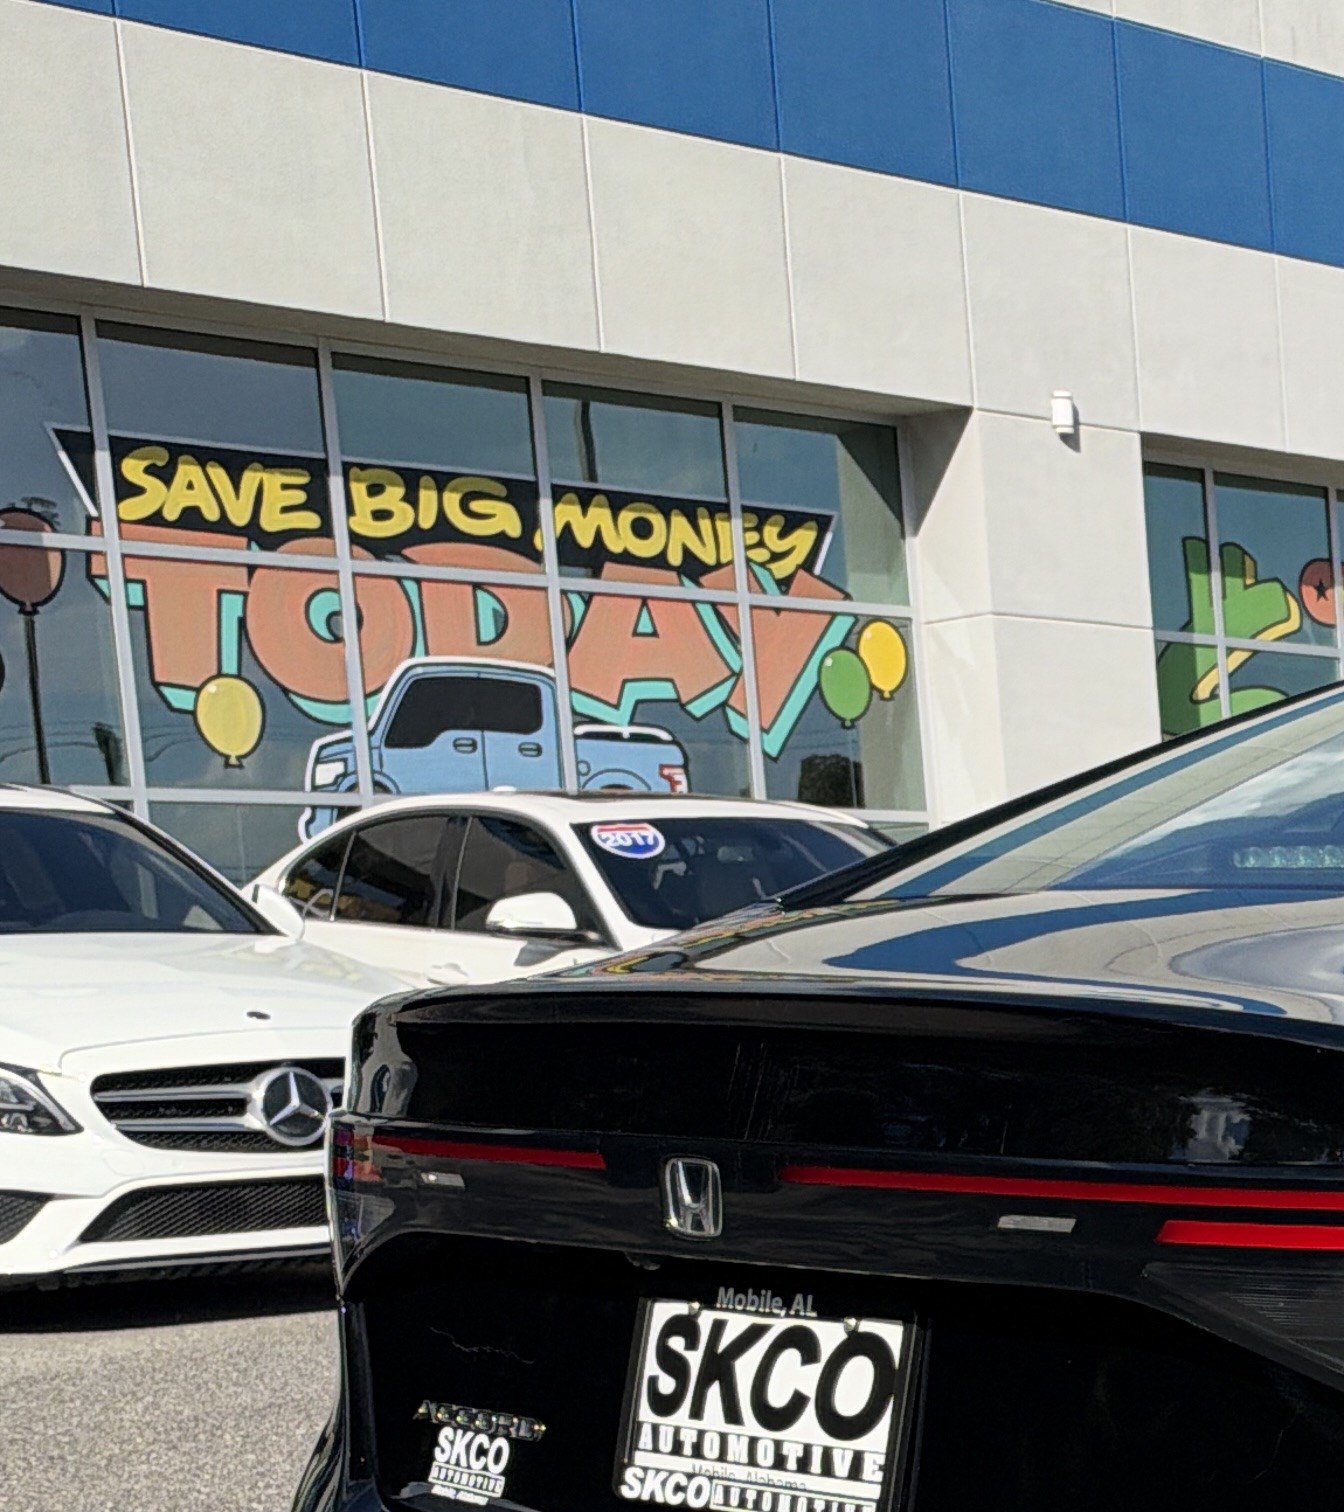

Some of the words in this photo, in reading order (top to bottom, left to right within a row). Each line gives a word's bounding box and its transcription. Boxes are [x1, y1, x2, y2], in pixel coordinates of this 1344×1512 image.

[118, 445, 322, 532] SAVE
[349, 467, 522, 539] BIG
[534, 492, 818, 580] MONEY
[90, 517, 858, 758] TODAY
[600, 831, 656, 847] 2017
[715, 1286, 787, 1318] Mobile,
[789, 1292, 818, 1318] AL
[647, 1313, 897, 1442] SKCO
[434, 1426, 511, 1475] SKCO
[637, 1422, 886, 1483] AUTOMOTIVE
[430, 1464, 504, 1494] AUTOMOTIVE
[620, 1466, 711, 1509] SKCO
